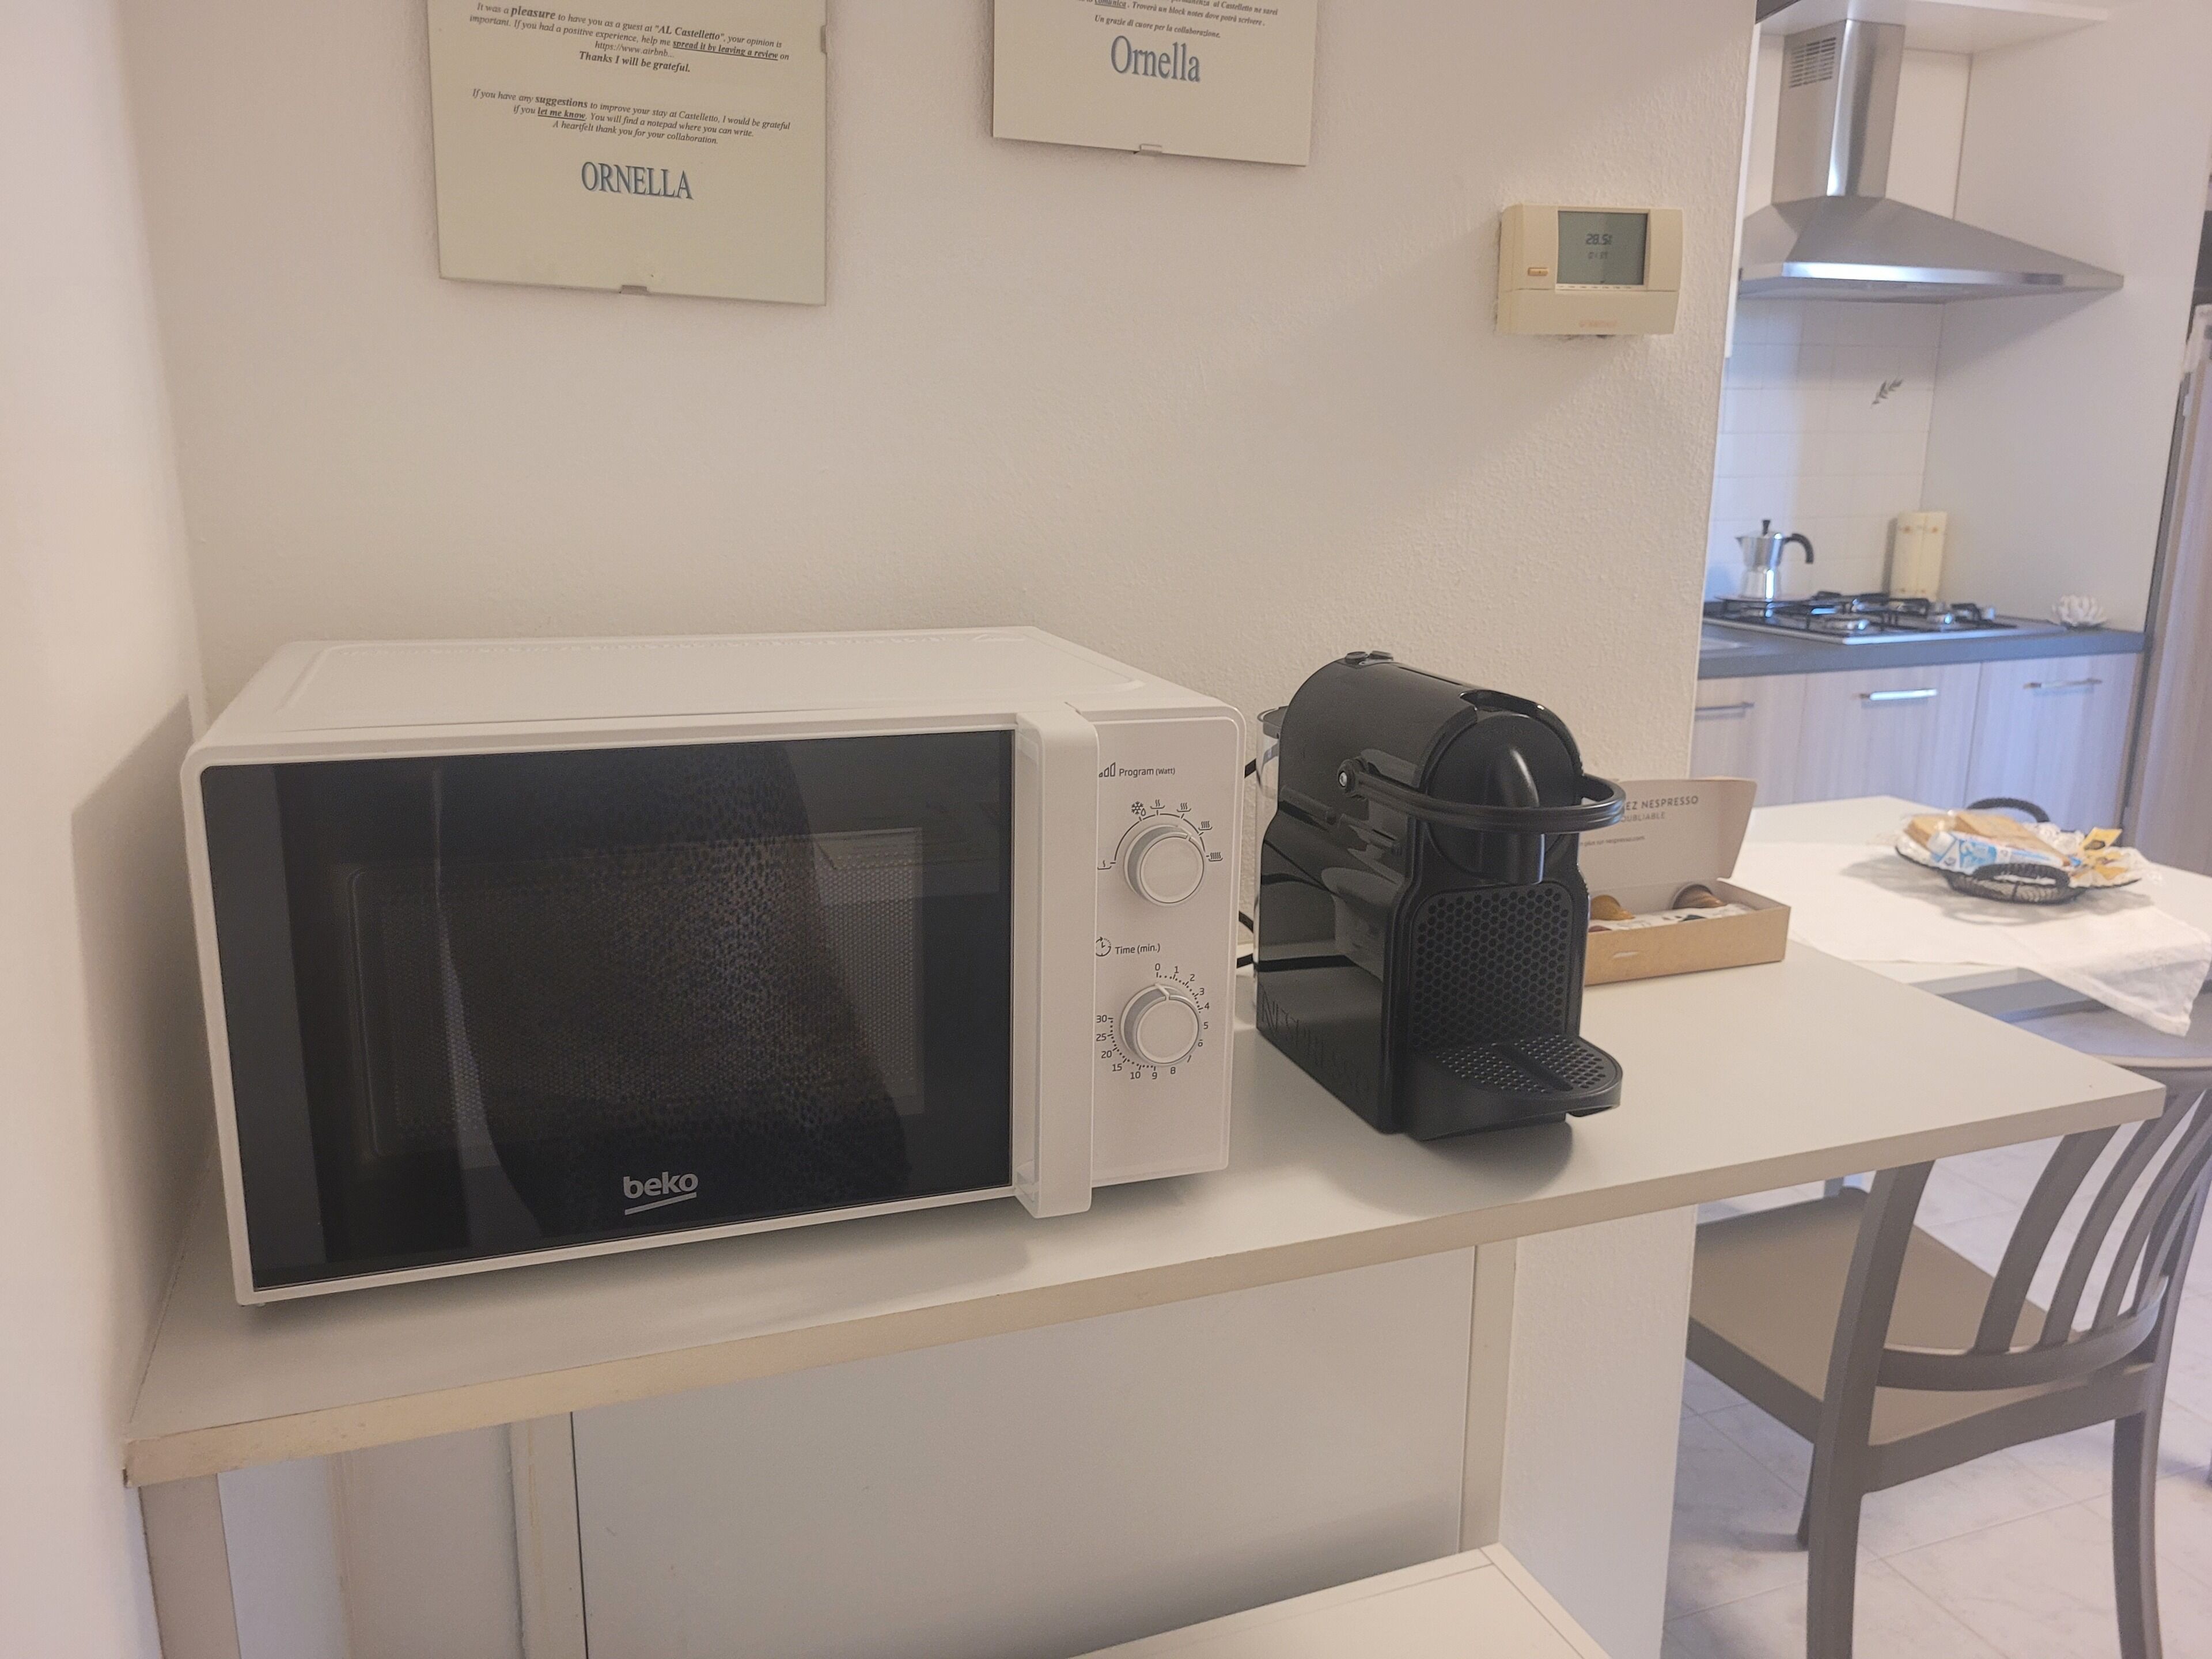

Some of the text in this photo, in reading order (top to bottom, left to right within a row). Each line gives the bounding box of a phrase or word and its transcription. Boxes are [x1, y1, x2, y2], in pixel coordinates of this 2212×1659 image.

[510, 6, 555, 20] pleasure
[567, 14, 586, 24] have
[655, 25, 672, 34] "AL
[746, 37, 774, 47] opinion
[469, 14, 511, 26] important.
[514, 20, 522, 30] If
[539, 23, 554, 32] had
[562, 27, 593, 36] positive
[595, 32, 639, 43] experience,
[641, 35, 658, 46] help
[672, 41, 698, 49] spread
[699, 42, 706, 50] it
[707, 43, 717, 53] by
[718, 44, 745, 56] leaving
[753, 50, 778, 59] review
[579, 52, 690, 73] Thanks I will be grateful.
[1111, 35, 1200, 82] Ornella
[472, 89, 481, 99] If
[480, 92, 496, 100] you
[497, 92, 516, 101] have
[518, 96, 533, 104] any
[535, 96, 587, 108] suggestions
[600, 103, 630, 113] improve
[652, 109, 667, 119] stay
[679, 111, 720, 123] Castelletto,
[761, 121, 790, 131] grateful
[513, 105, 521, 115] if
[520, 108, 536, 116] you
[537, 108, 547, 116] let
[564, 111, 587, 120] know.
[590, 113, 605, 122] You
[607, 115, 621, 123] will
[622, 116, 638, 126] find
[646, 120, 677, 130] notepad
[679, 123, 701, 131] where
[733, 128, 753, 137] write.
[560, 122, 593, 132] heartfelt
[596, 125, 616, 134] thank
[634, 128, 645, 138] for
[666, 133, 718, 144] collaboration.
[581, 161, 694, 200] ORNELLA
[1119, 767, 1175, 778] Program (Watt)
[1641, 796, 1698, 809] NESPRESSO
[1115, 943, 1161, 955] Time (min.)
[1154, 963, 1161, 971] 0
[1174, 965, 1179, 974] 1
[1189, 974, 1195, 982] 2
[1199, 987, 1205, 995] 3
[1204, 1002, 1210, 1010] 4
[1096, 1014, 1108, 1023] 30
[1203, 1021, 1209, 1029] 5
[1096, 1033, 1107, 1041] 25
[1197, 1039, 1203, 1047] 6
[1101, 1050, 1112, 1059] 20
[1112, 1063, 1123, 1071] 15
[1170, 1066, 1176, 1074] 8
[1130, 1071, 1141, 1080] 10
[1152, 1071, 1158, 1080] 9
[623, 1171, 699, 1199] beko
